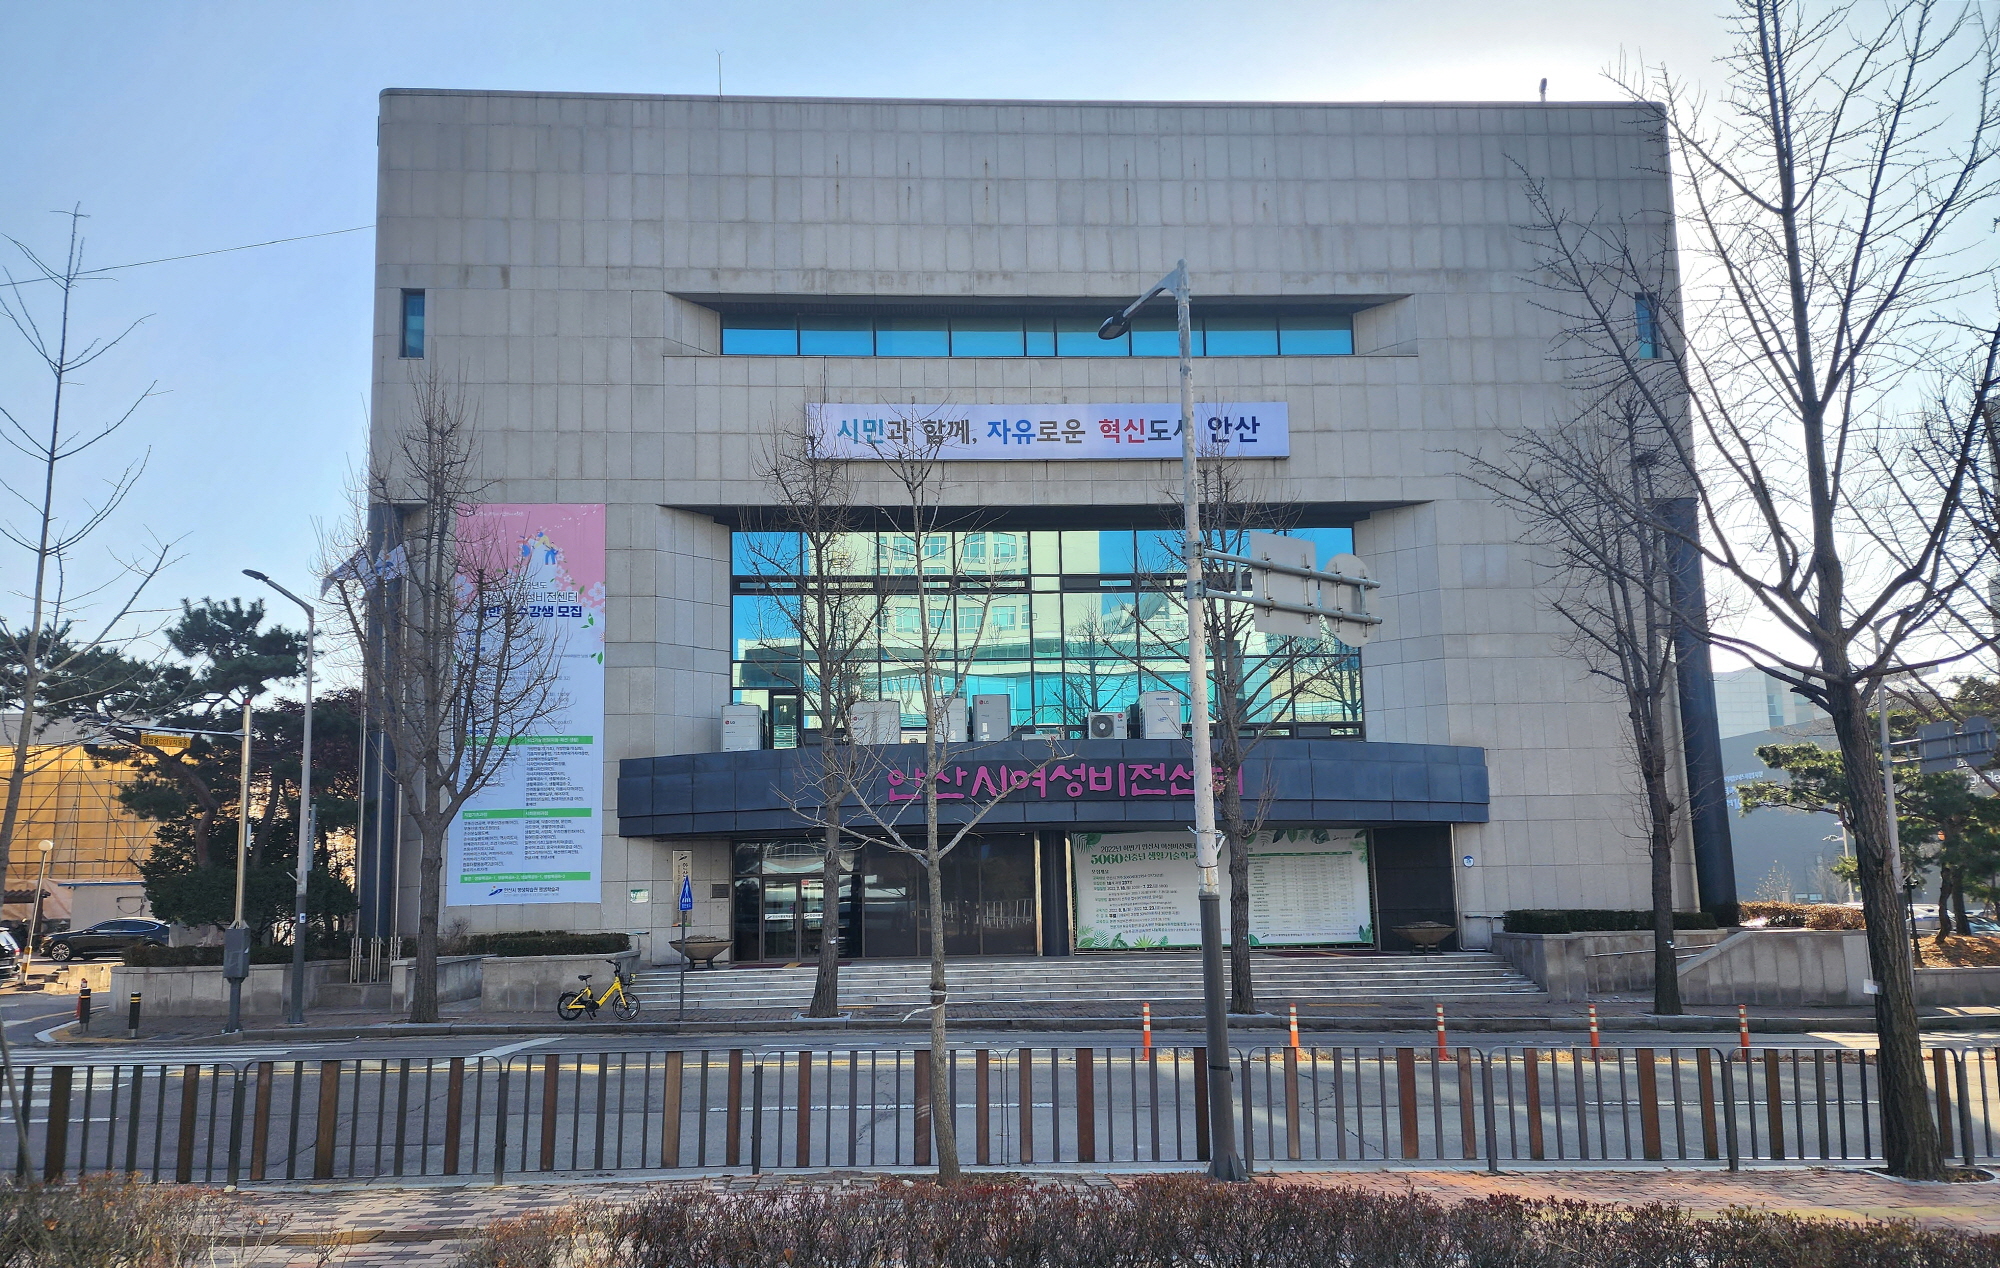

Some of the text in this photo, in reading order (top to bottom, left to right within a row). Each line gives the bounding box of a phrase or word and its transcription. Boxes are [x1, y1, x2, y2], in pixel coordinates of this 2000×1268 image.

[837, 418, 911, 445] 시민과
[923, 418, 977, 446] 함께,
[987, 418, 1086, 445] 자유로운
[1207, 416, 1260, 444] 안산
[557, 605, 582, 618] 모집
